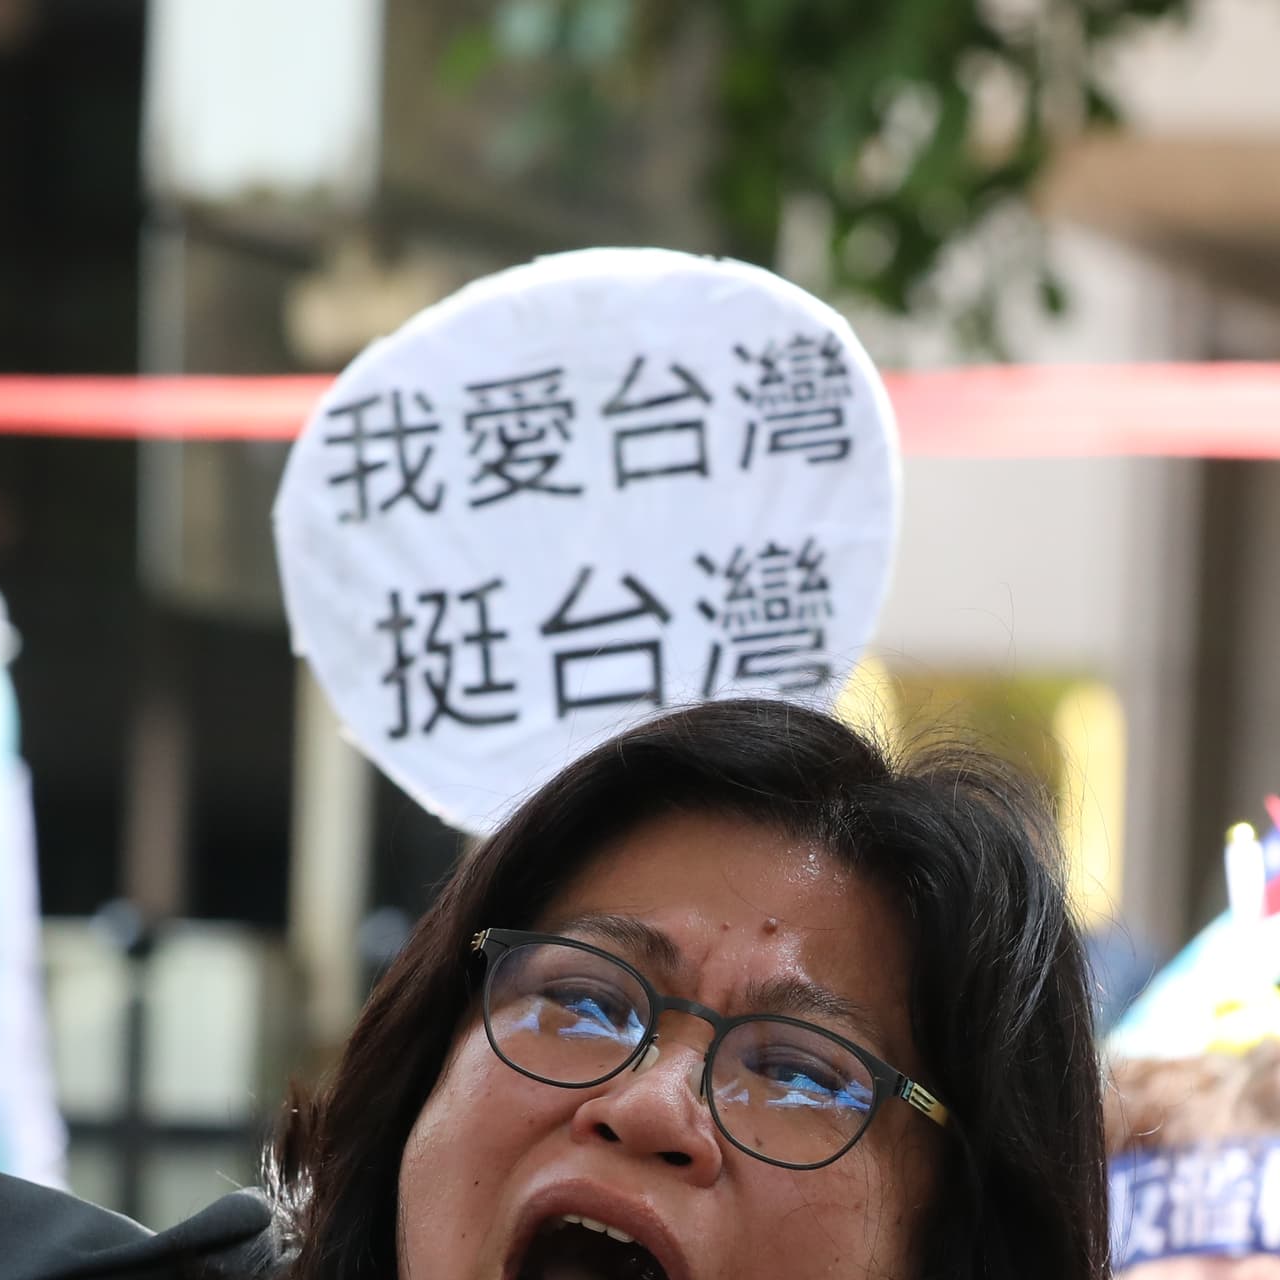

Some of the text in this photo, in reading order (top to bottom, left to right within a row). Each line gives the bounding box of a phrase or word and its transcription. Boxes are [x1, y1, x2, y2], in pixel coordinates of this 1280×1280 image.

[322, 330, 854, 524] 我愛台灣
[373, 537, 836, 741] 挺台灣
